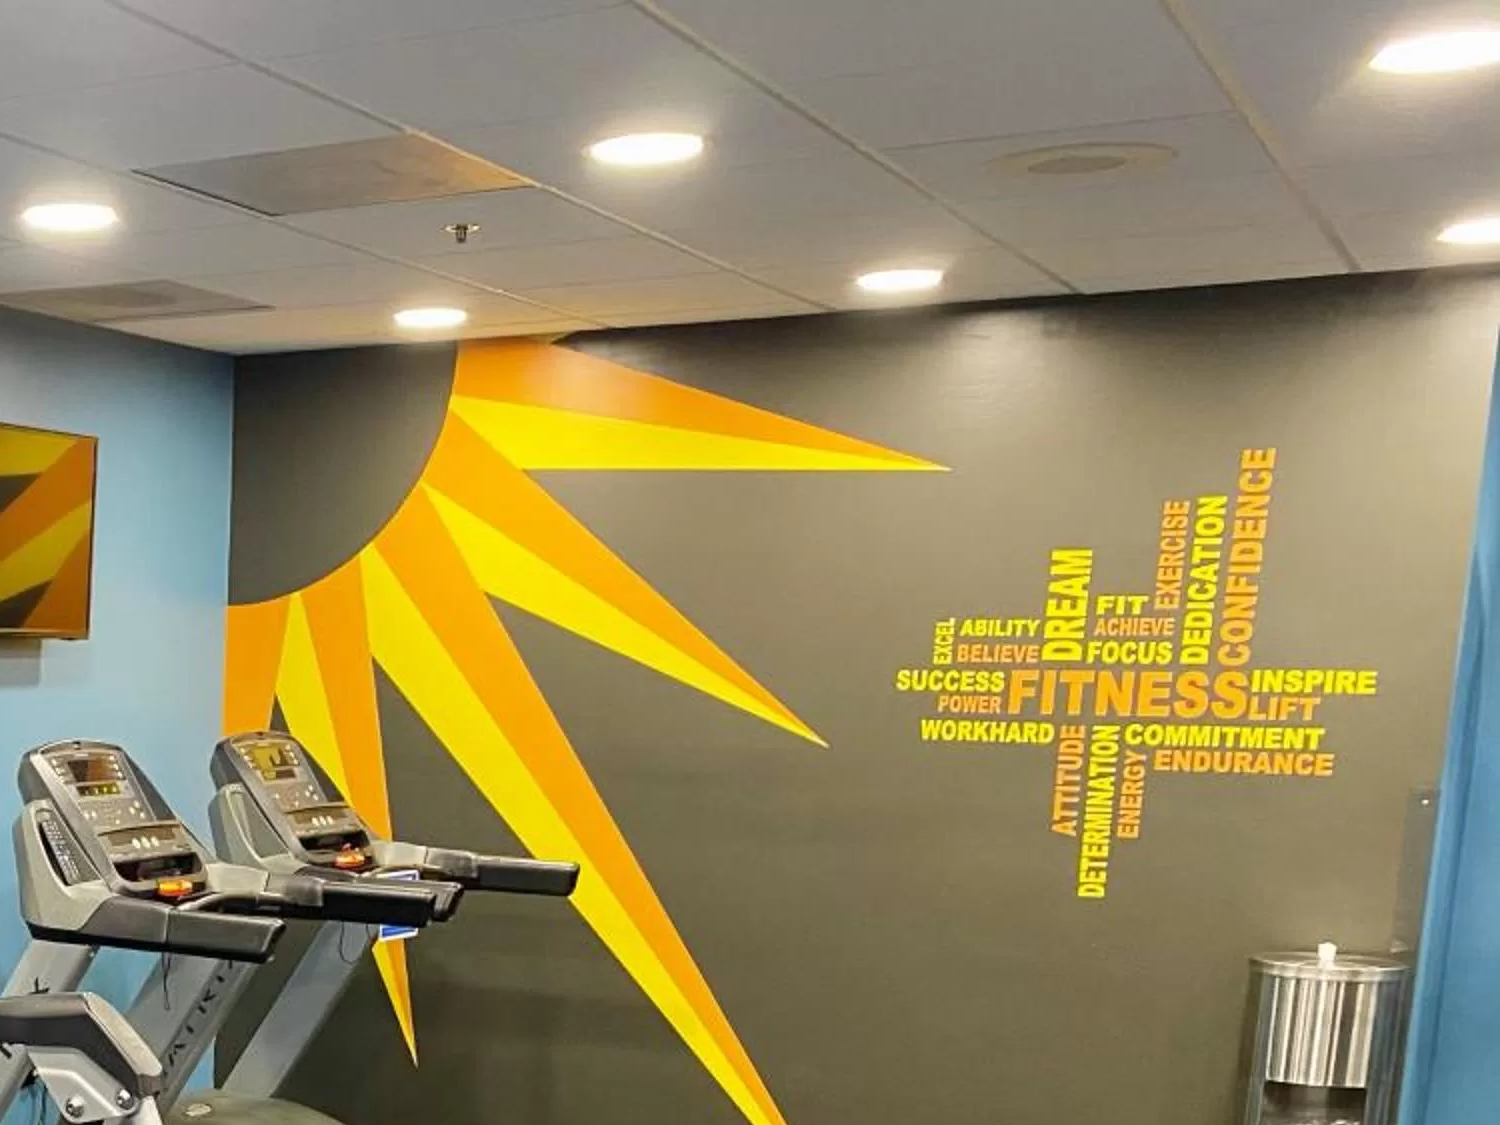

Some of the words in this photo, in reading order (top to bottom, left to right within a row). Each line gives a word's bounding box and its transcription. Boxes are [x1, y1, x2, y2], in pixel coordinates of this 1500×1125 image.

[1154, 499, 1190, 610] EXERCISE
[1218, 447, 1276, 667] CONFIDENCE
[1180, 495, 1228, 665] DEDICATION
[1042, 548, 1092, 661] DREAM
[1096, 595, 1148, 615] FIT
[960, 619, 1041, 637] ABILITY
[1094, 618, 1175, 636] ACHIEVE
[933, 617, 956, 665] EXCEL
[957, 644, 1039, 663] BELIEVE
[1087, 641, 1173, 665] FOCUS
[896, 669, 1005, 692] SUCCESS
[1251, 669, 1378, 695] INSPIRE
[937, 695, 1002, 714] POWER
[1007, 669, 1250, 720] FITNESS
[1248, 697, 1321, 721] LIFT
[920, 719, 1055, 744] WORKHARD
[1124, 724, 1325, 751] COMMITMENT
[1153, 750, 1335, 777] ENDURANCE
[1050, 725, 1086, 837] ATTITUDE
[1116, 750, 1148, 839] ENERGY
[1077, 725, 1120, 899] DETERMINATION
